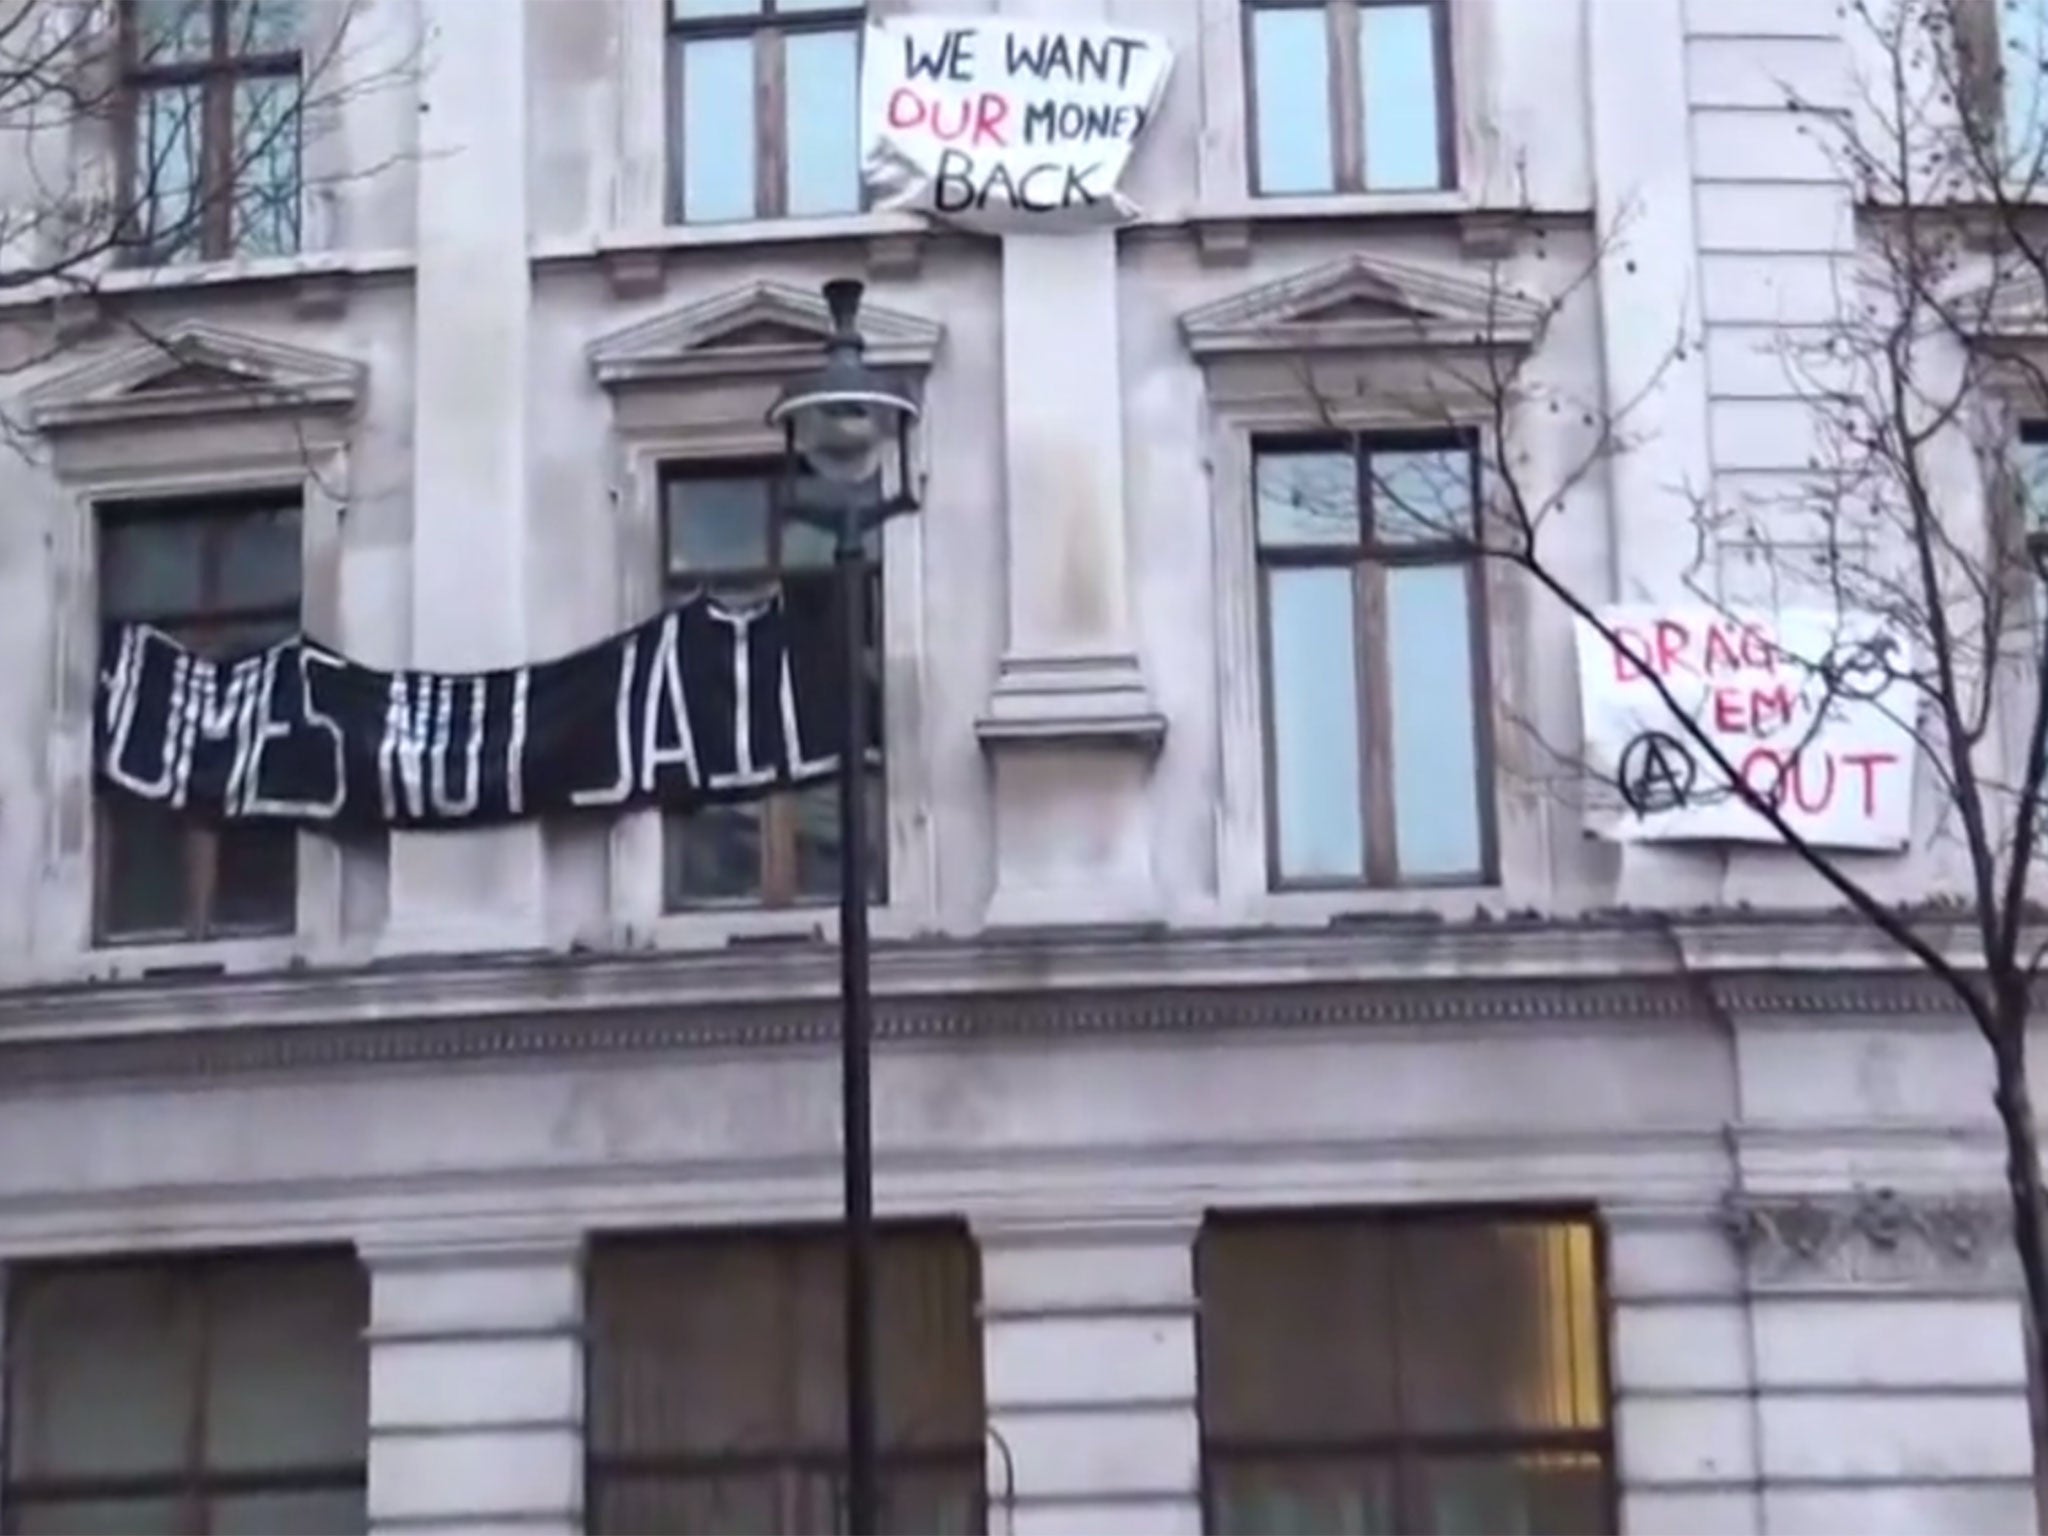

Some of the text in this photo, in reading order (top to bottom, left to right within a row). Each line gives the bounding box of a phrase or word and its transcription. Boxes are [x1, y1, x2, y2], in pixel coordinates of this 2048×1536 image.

[904, 29, 1148, 91] WE WANT
[887, 87, 1147, 147] OUR MONEY
[934, 147, 1104, 213] BACK
[1613, 617, 1777, 683] DRAG
[1741, 748, 1899, 818] OUT
